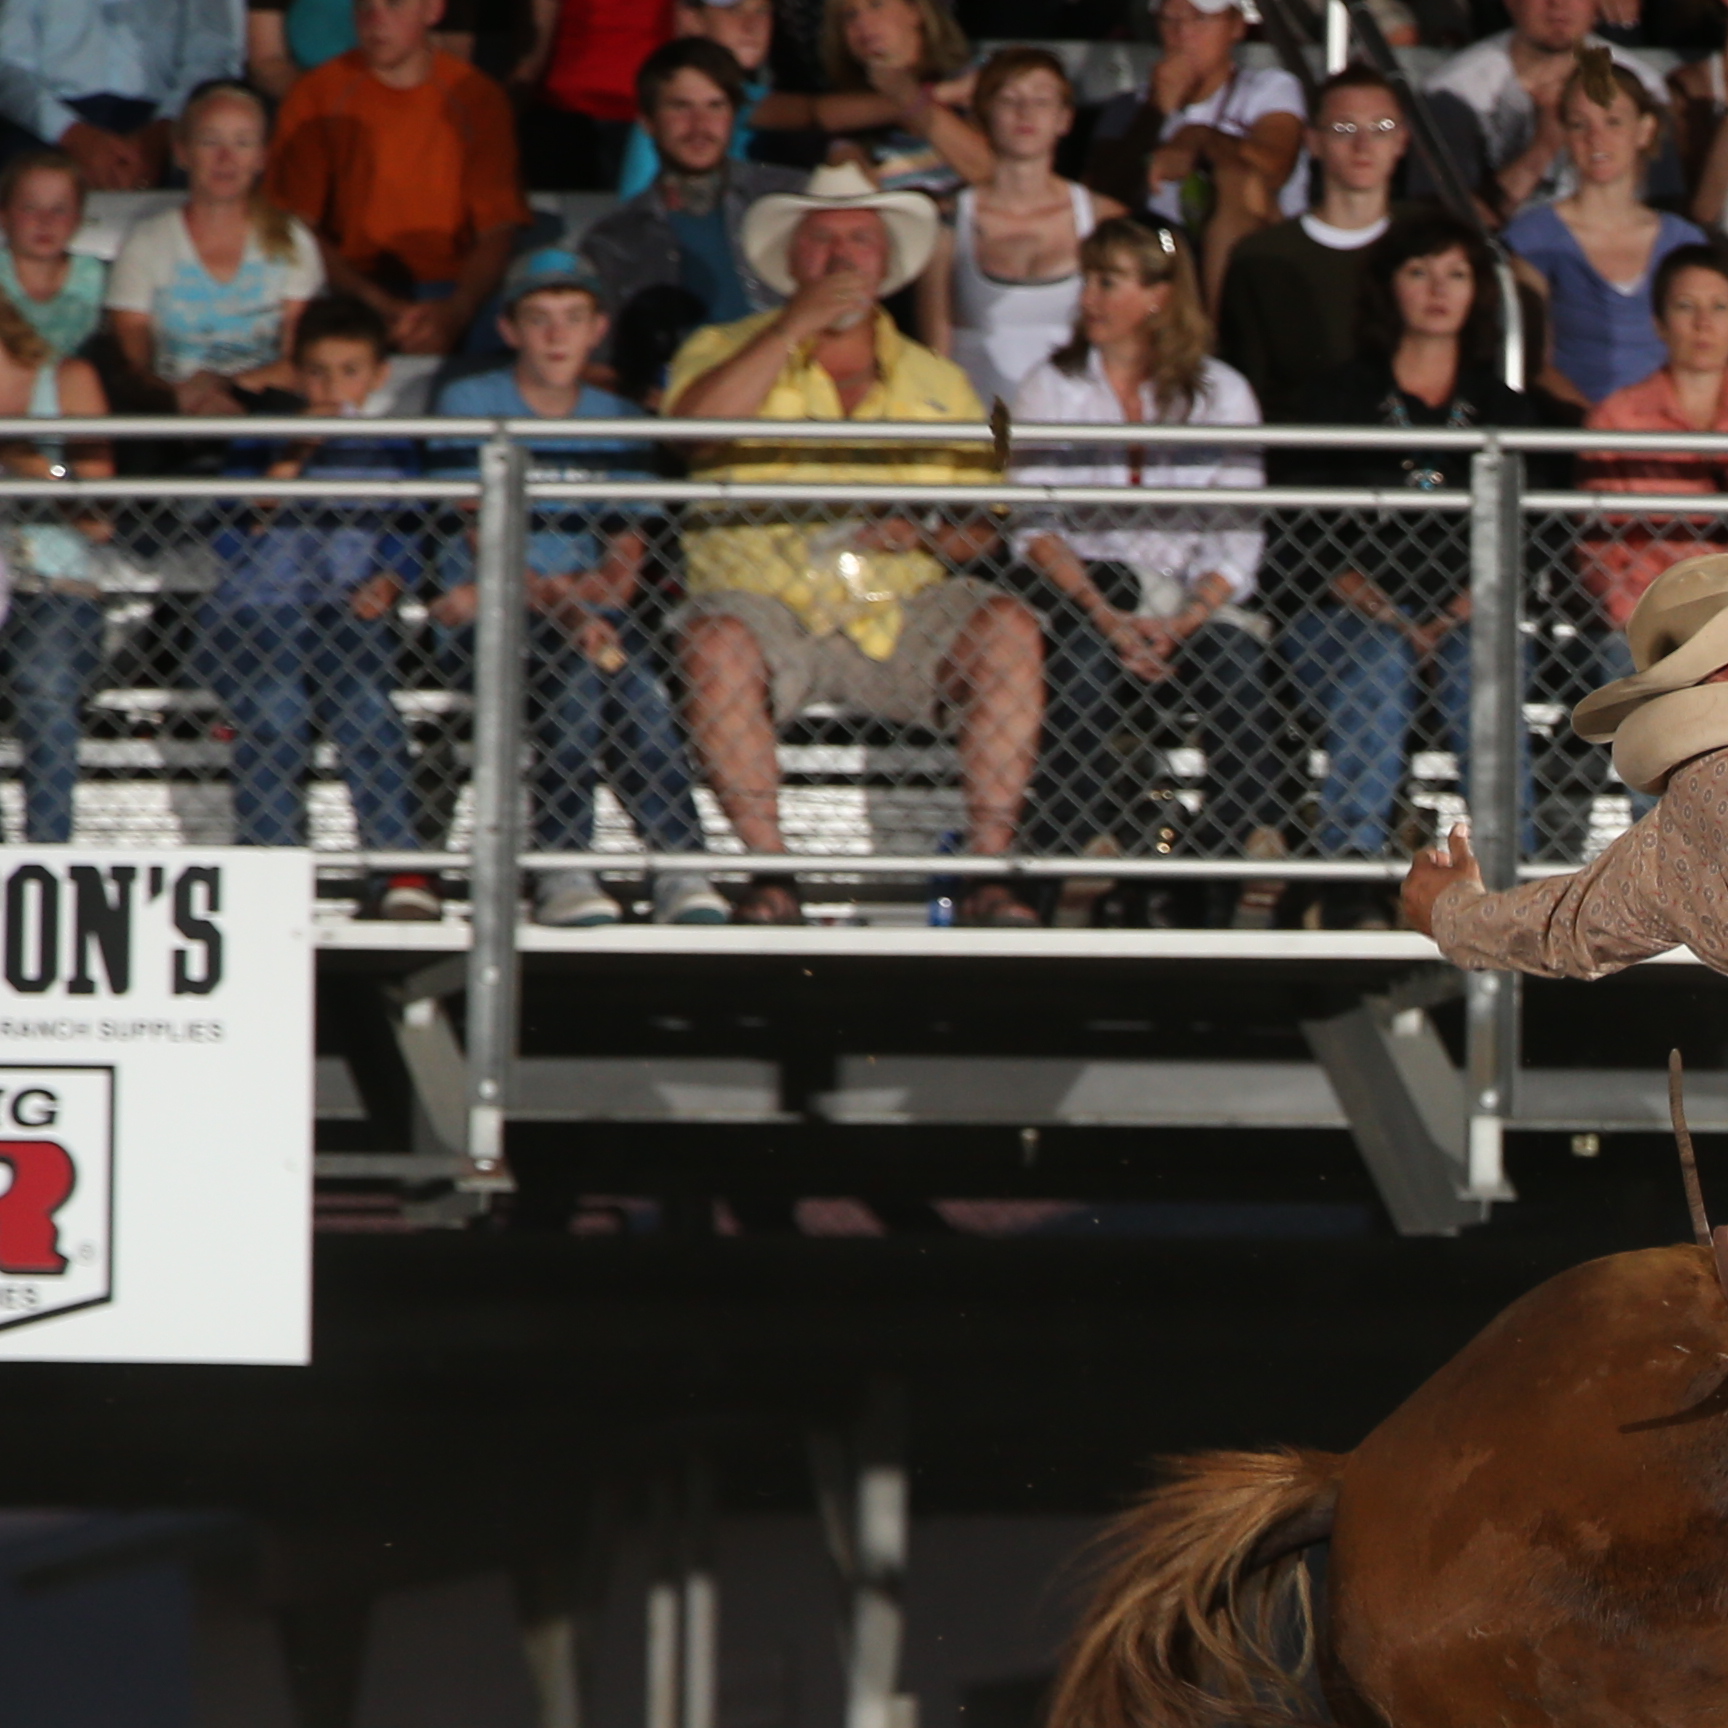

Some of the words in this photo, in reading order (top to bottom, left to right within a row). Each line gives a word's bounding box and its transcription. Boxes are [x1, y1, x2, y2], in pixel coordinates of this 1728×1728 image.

[4, 865, 223, 995] ON'S
[99, 1018, 223, 1043] SUPPLIES
[0, 1088, 59, 1128] G
